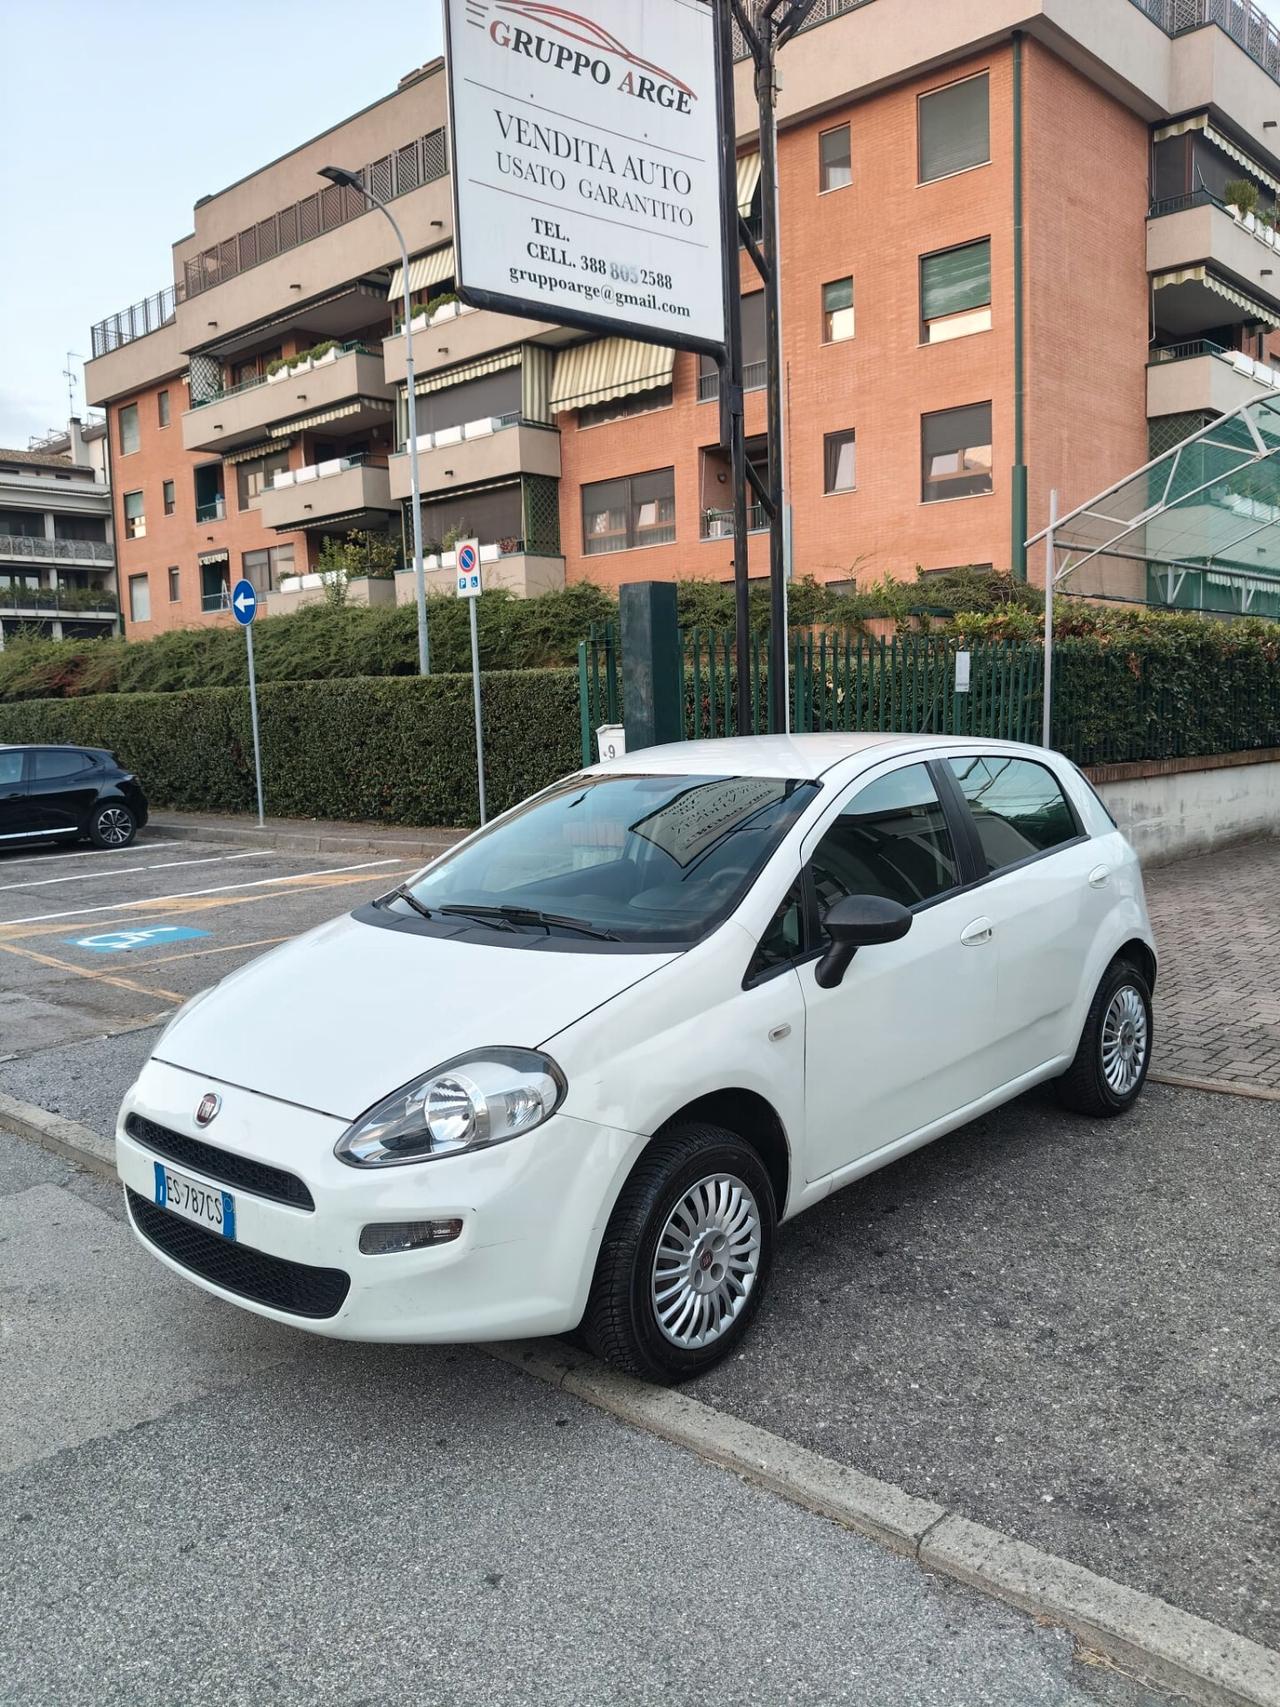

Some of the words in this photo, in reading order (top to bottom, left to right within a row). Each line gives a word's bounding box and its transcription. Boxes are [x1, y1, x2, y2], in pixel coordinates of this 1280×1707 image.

[489, 20, 611, 86] GRUPPO
[617, 71, 693, 115] ARGE
[494, 108, 616, 174] VENDITA
[621, 154, 693, 196] AUTO
[496, 151, 567, 191] USATO
[578, 178, 694, 227] GARANTITO
[530, 217, 570, 243] TEL.
[526, 241, 577, 269] CELL.
[580, 255, 607, 276] 388
[640, 268, 673, 290] 2588
[509, 266, 691, 318] gruppoarge@gmail.com
[608, 744, 616, 759] 9
